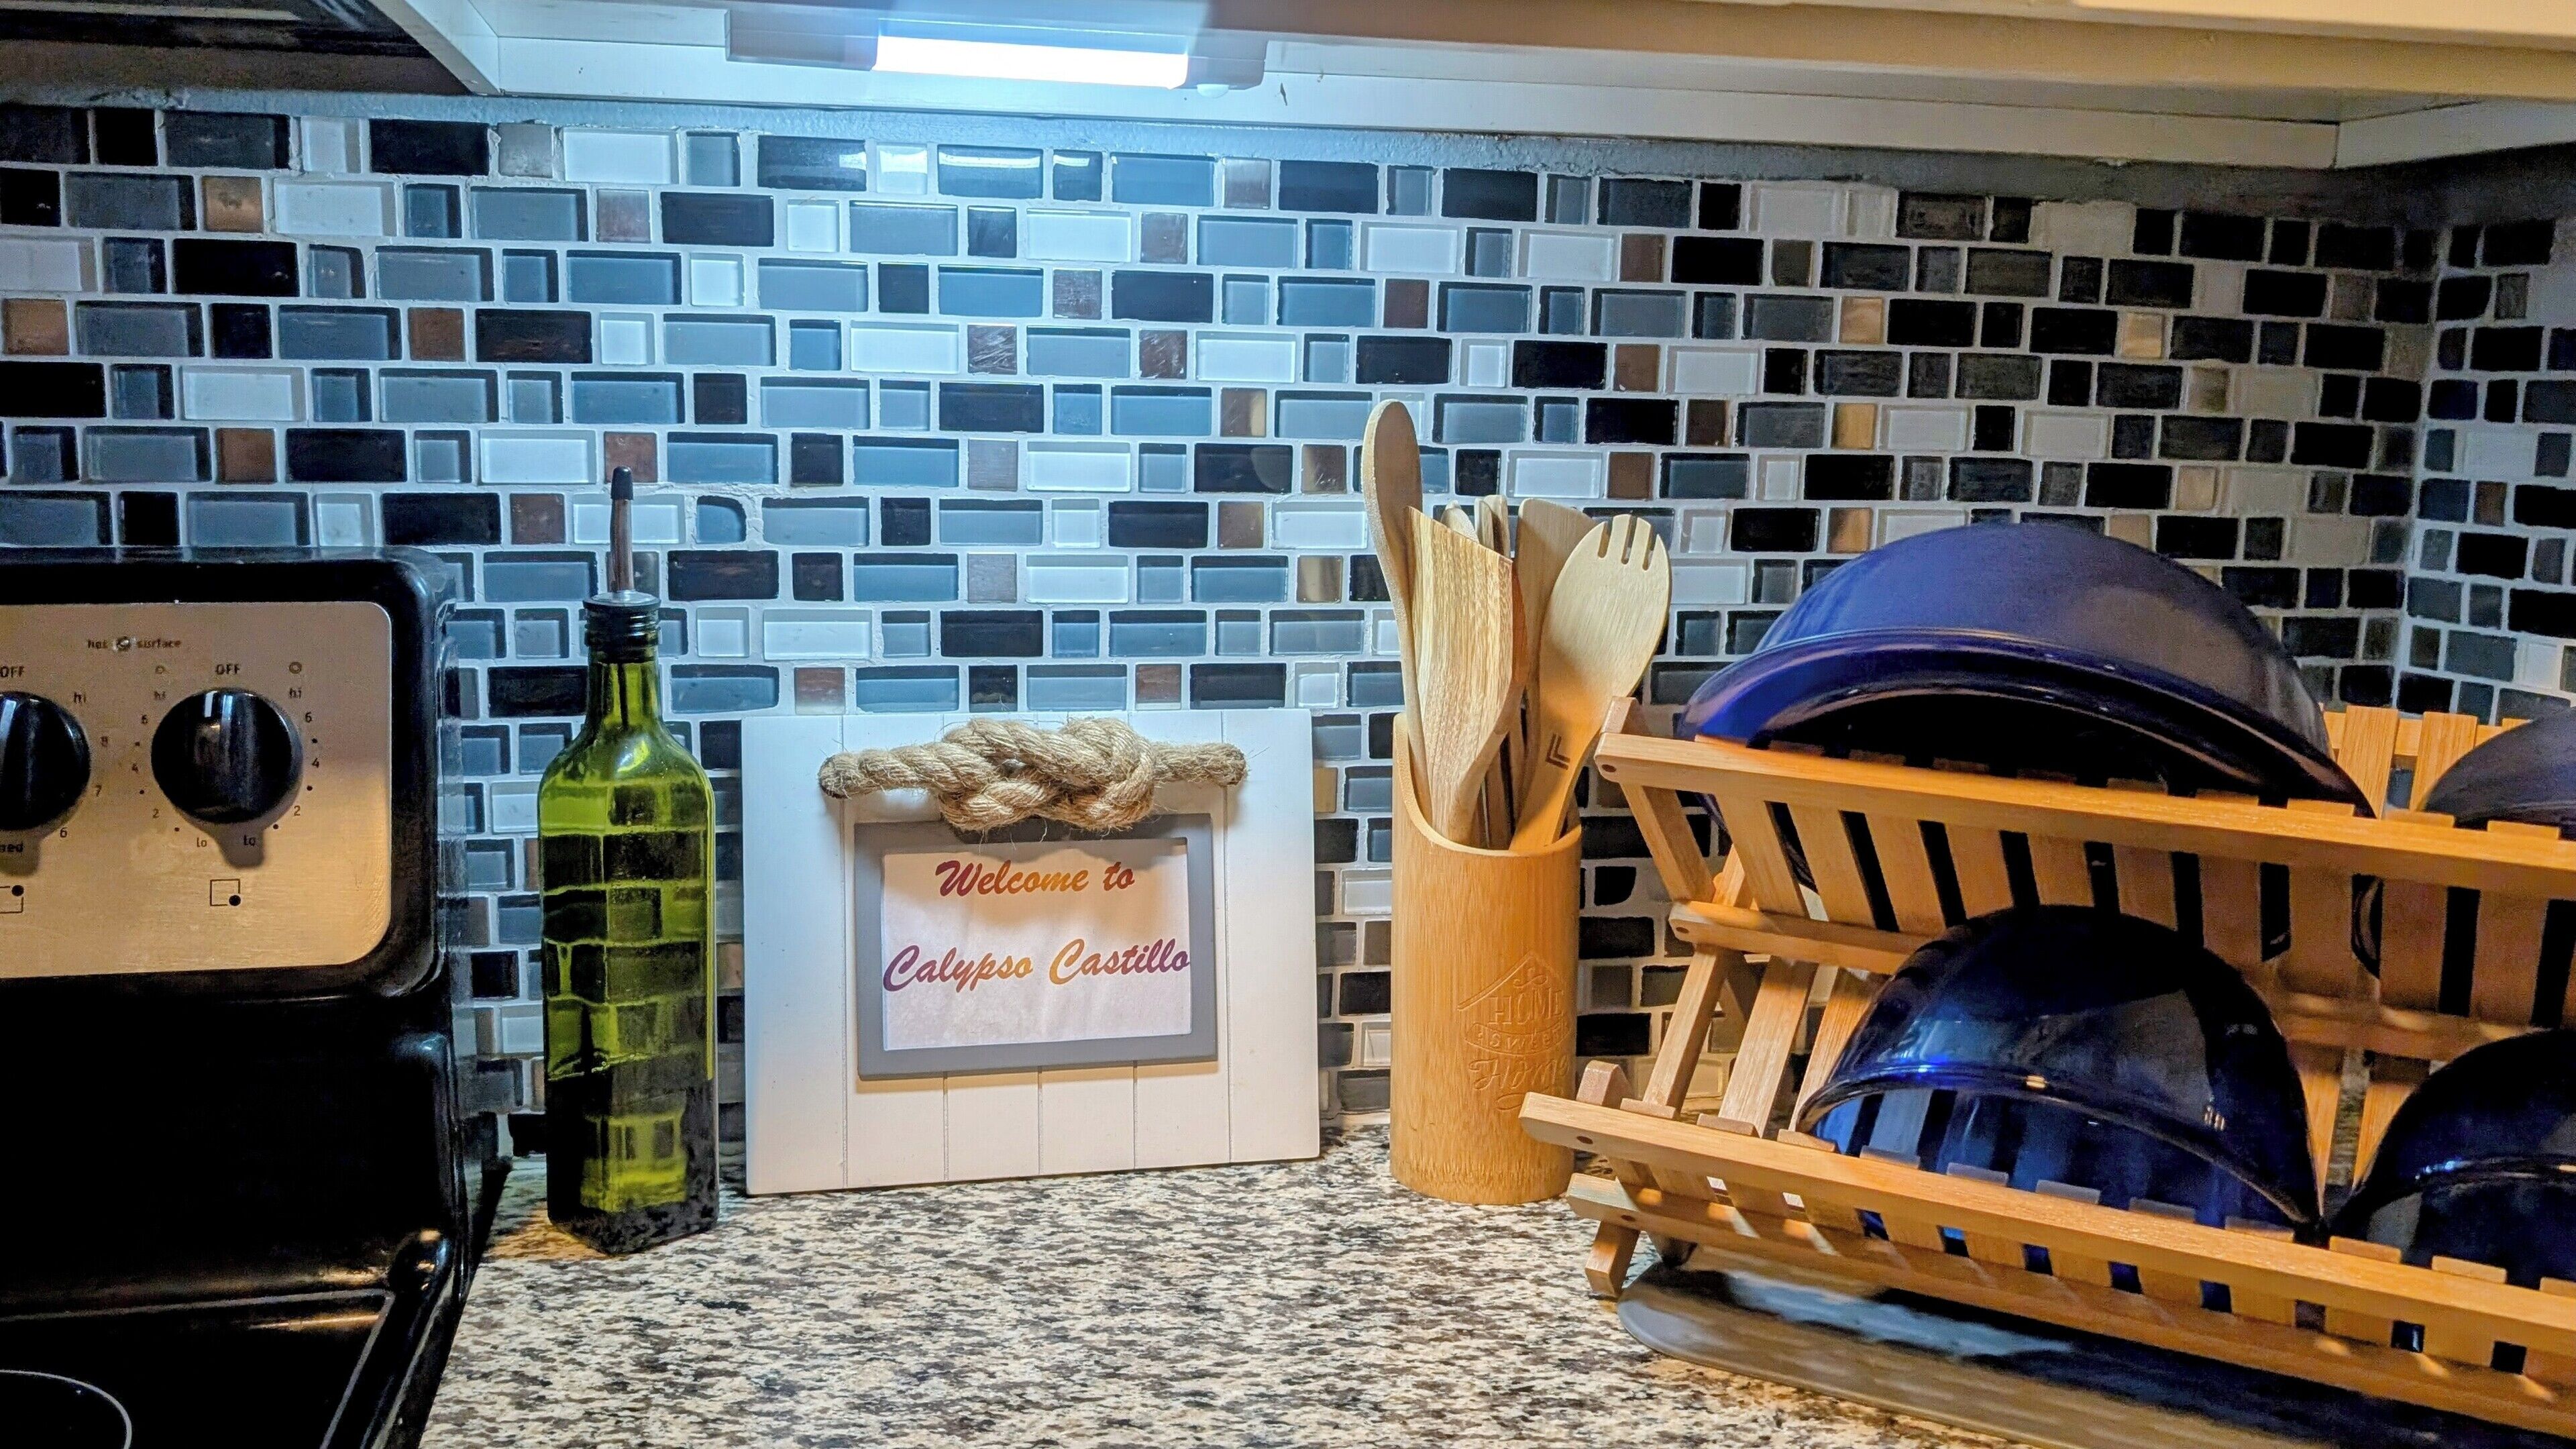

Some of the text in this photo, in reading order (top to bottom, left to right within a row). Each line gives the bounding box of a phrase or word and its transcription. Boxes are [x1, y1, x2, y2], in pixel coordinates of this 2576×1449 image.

[0, 666, 25, 678] OFF
[215, 664, 240, 675] OFF
[73, 692, 87, 703] hi
[154, 690, 166, 700] hi
[289, 688, 302, 698] hi
[305, 712, 312, 722] 6
[312, 757, 320, 768] 4
[95, 784, 102, 797] 7
[152, 808, 160, 818] 2
[293, 805, 301, 816] 2
[60, 827, 68, 838] 6
[197, 837, 207, 848] lo
[934, 859, 1136, 897] Welcome to
[883, 938, 1190, 993] Calypso Castillo
[1488, 987, 1564, 1025] HOME
